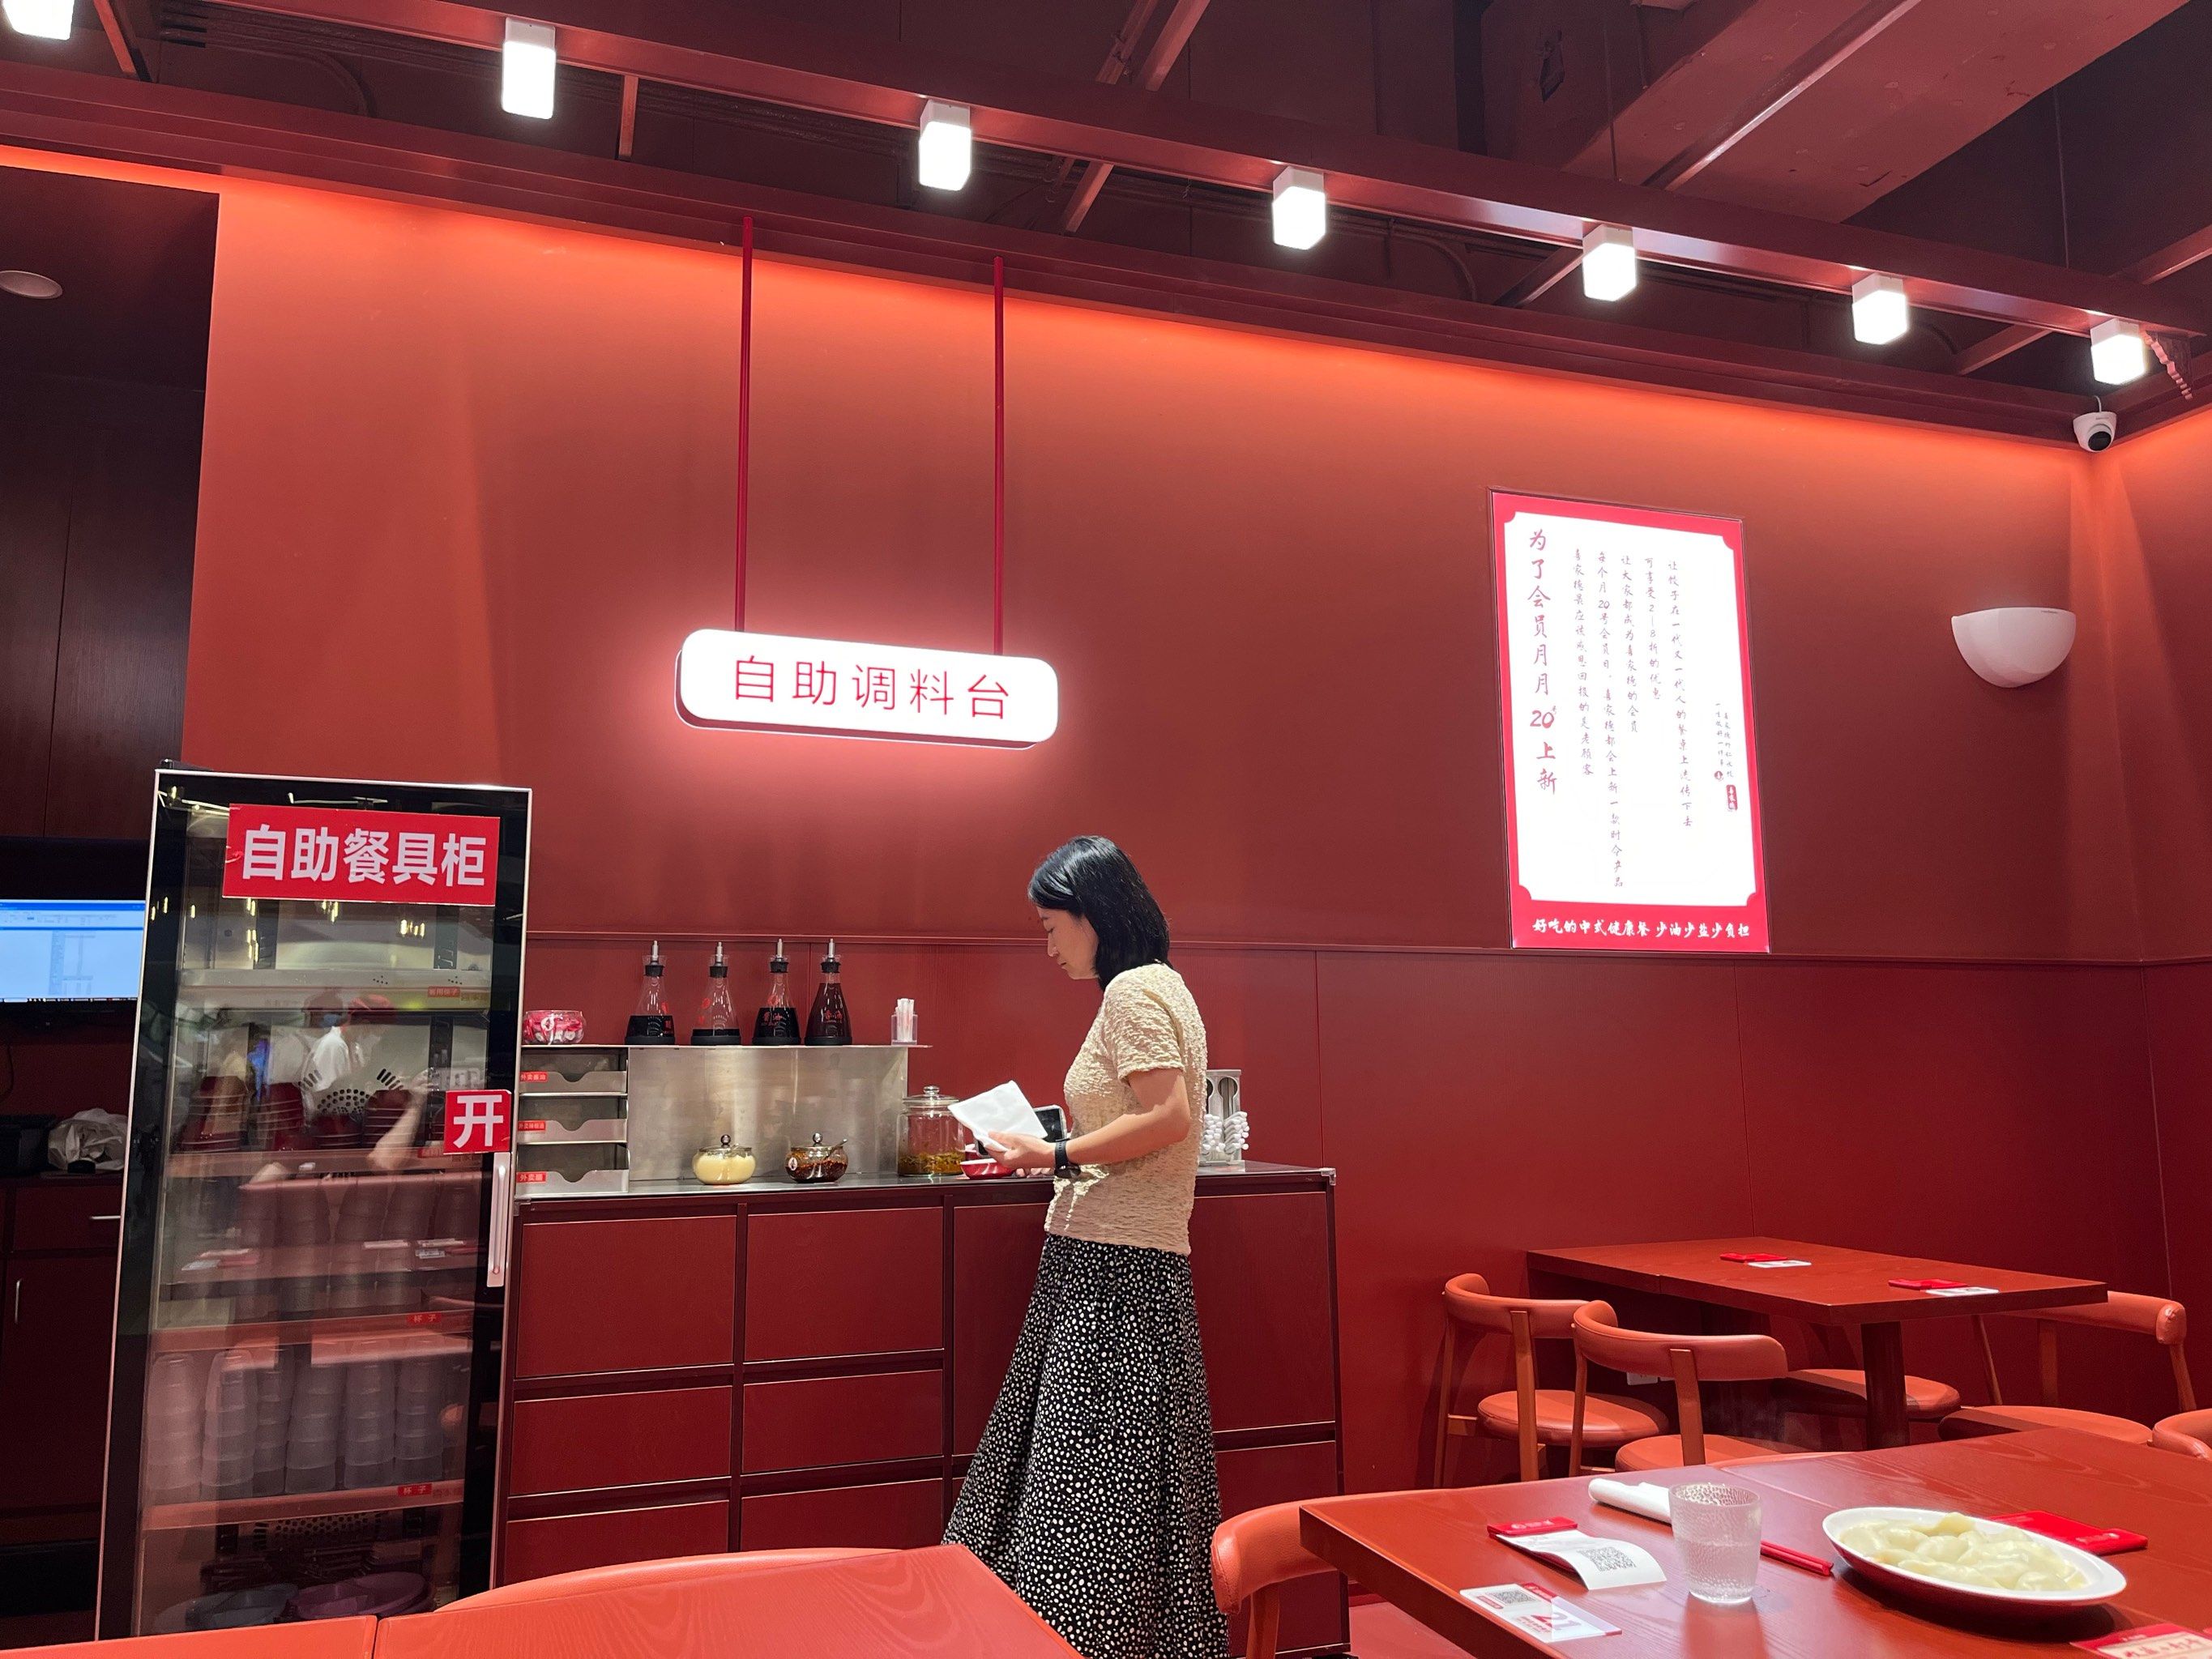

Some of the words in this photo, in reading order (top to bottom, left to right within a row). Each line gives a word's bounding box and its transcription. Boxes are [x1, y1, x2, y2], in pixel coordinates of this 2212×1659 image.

[734, 655, 1009, 720] 自助调料台
[241, 823, 486, 886] 自助餐具柜
[1531, 918, 1650, 937] 好吃的中式健康餐
[1655, 922, 1750, 939] 少油少盐少负担
[453, 1094, 504, 1148] 开
